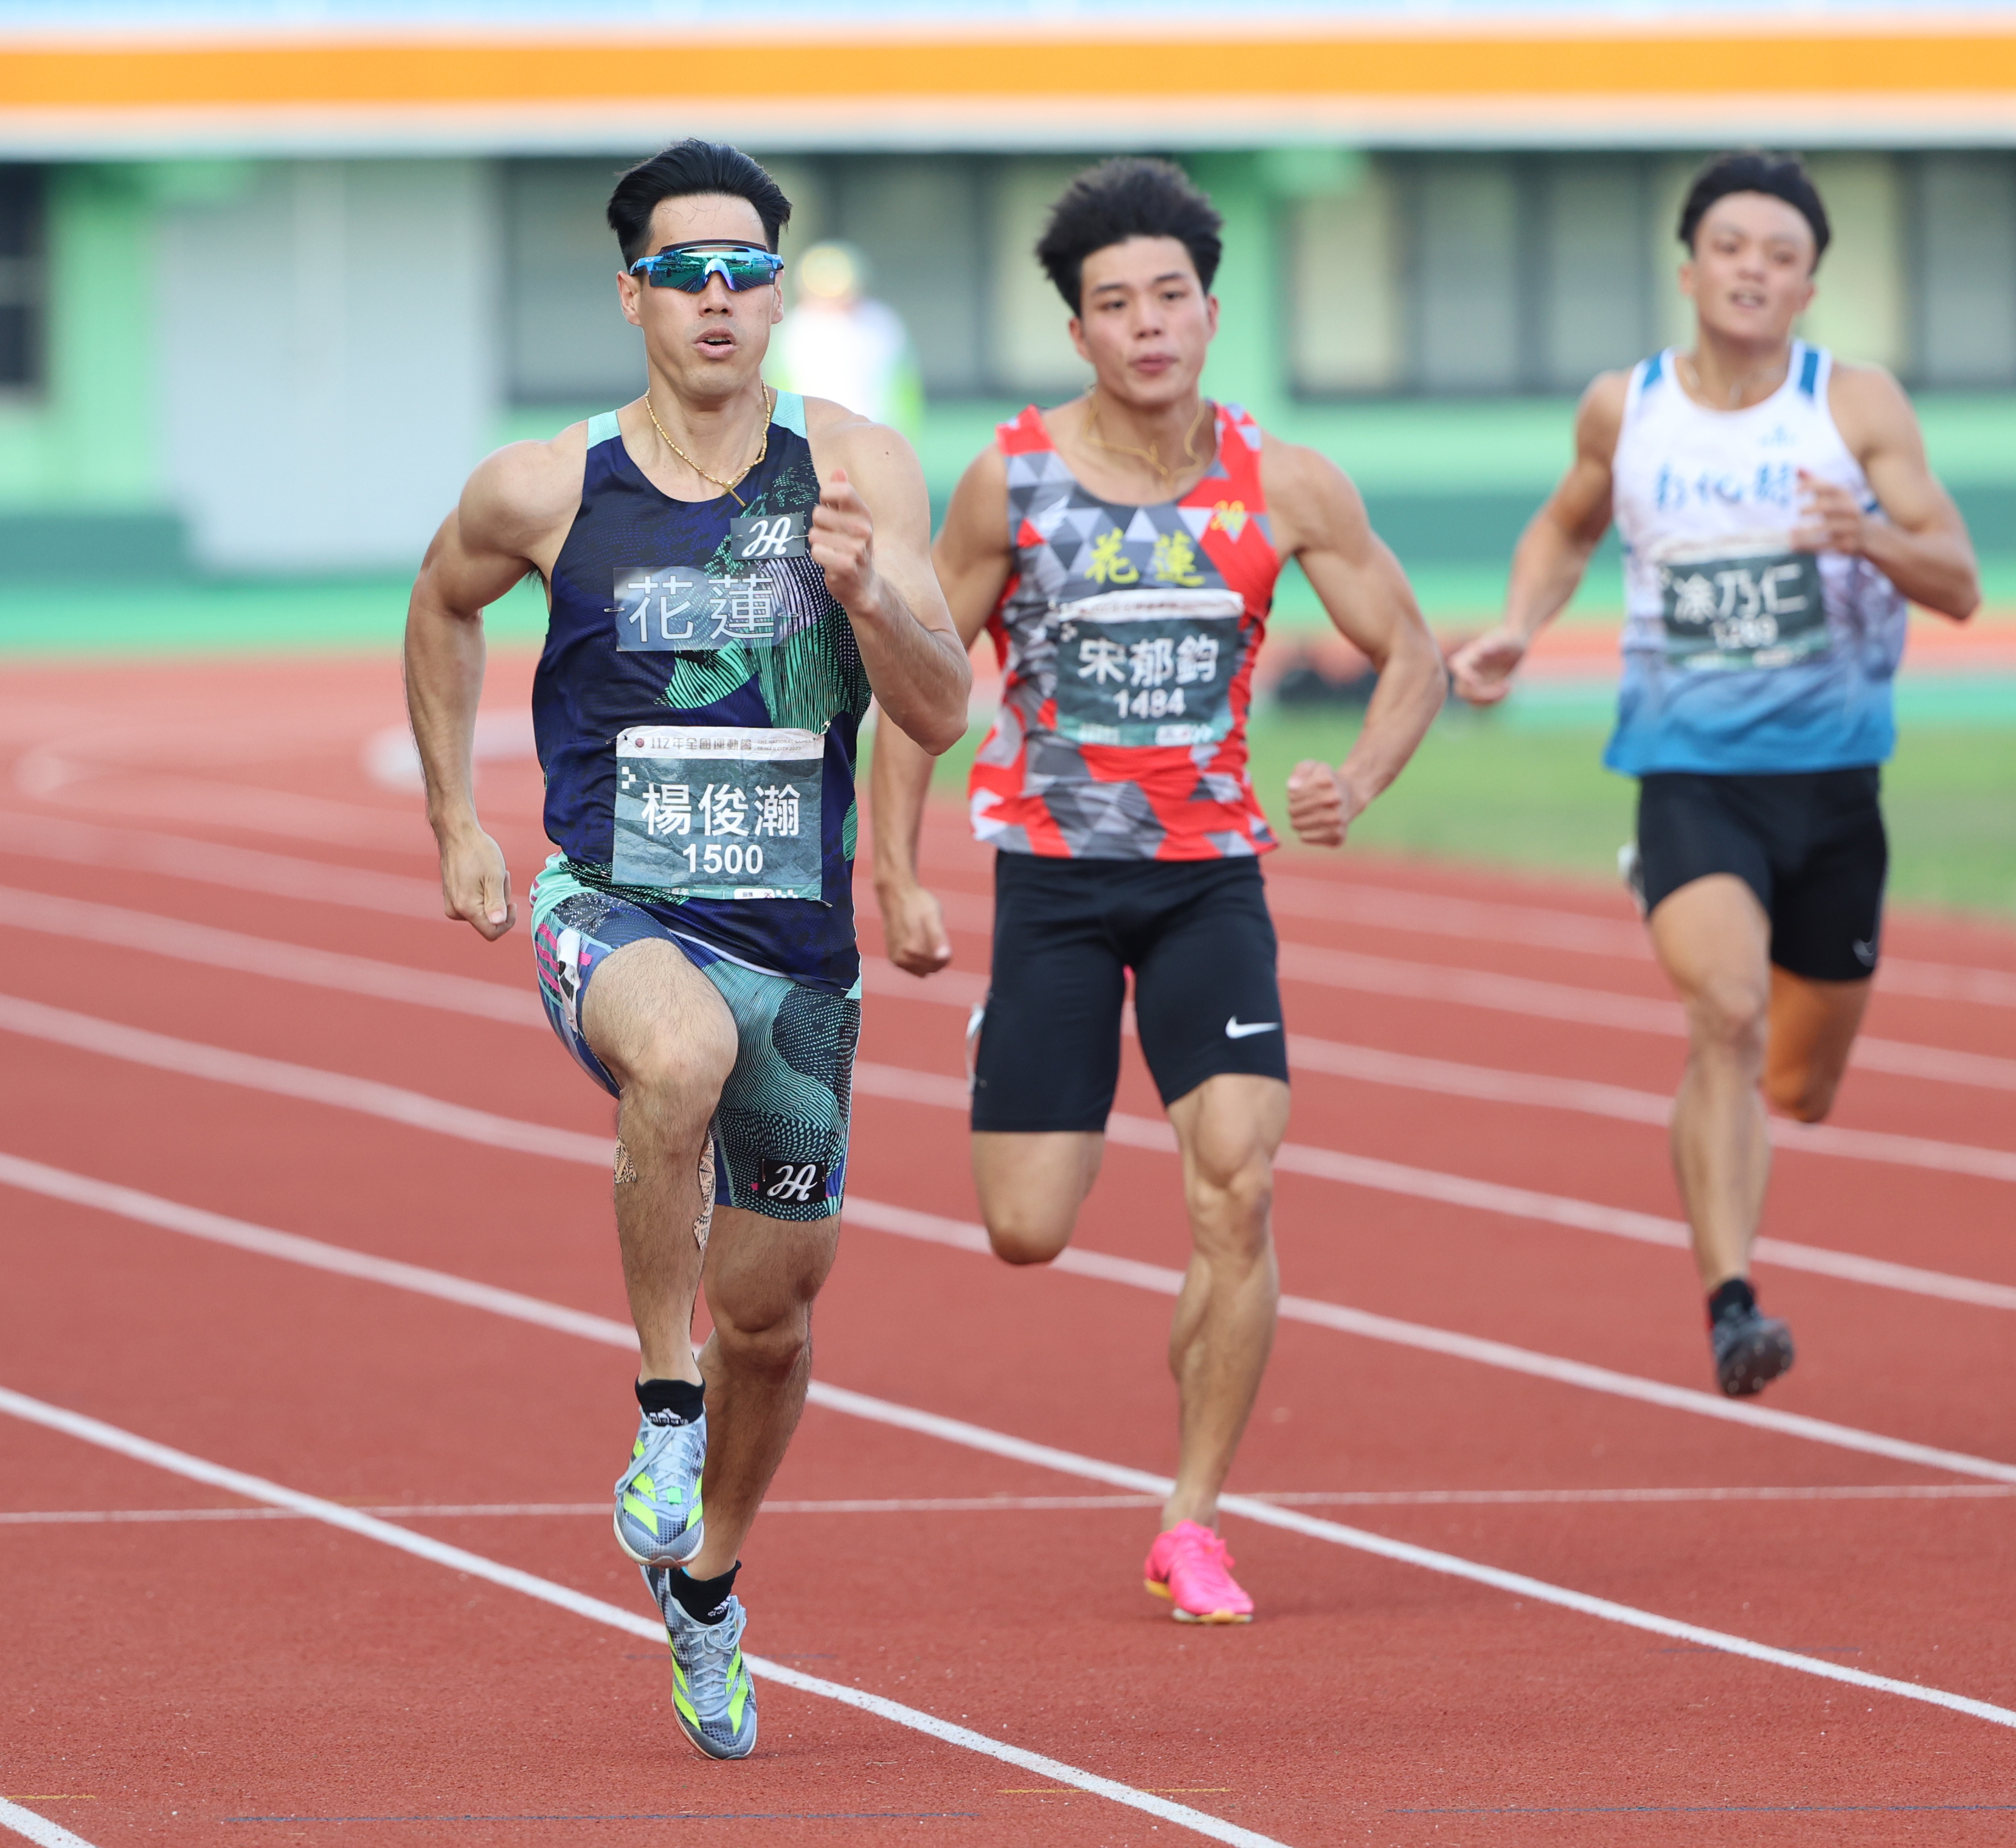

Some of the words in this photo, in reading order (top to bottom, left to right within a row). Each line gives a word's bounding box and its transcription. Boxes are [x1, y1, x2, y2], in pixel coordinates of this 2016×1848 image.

[1084, 527, 1206, 587] 花蓮
[627, 573, 775, 643] 花蓮
[1113, 687, 1186, 719] 1484
[642, 783, 801, 837] 楊俊瀚
[682, 843, 763, 874] 1500
